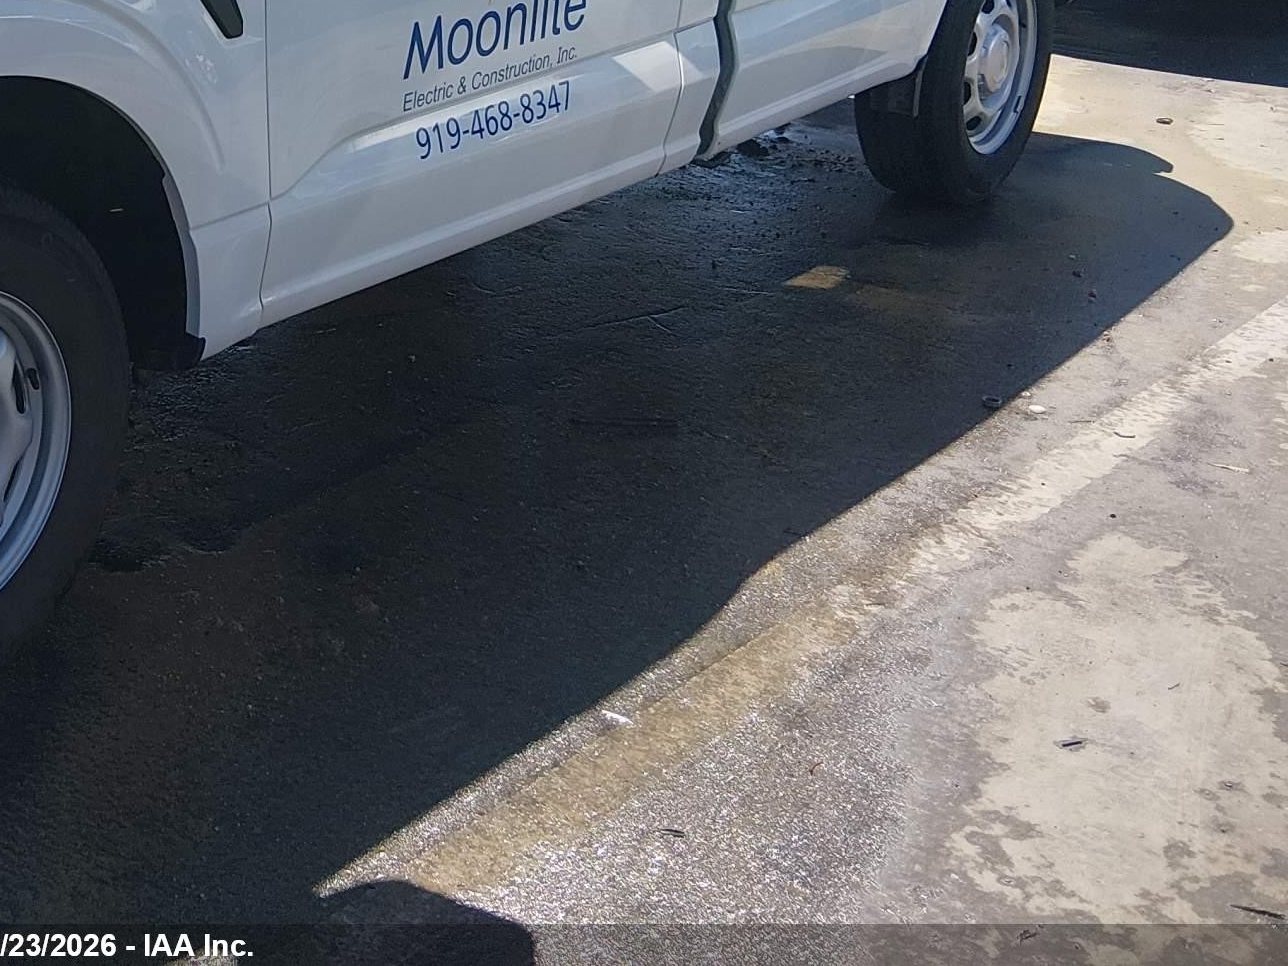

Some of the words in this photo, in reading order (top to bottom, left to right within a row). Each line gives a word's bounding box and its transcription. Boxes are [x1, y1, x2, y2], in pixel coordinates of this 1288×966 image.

[403, 81, 453, 112] Electric
[457, 76, 467, 95] &
[471, 54, 553, 91] Construction,
[557, 46, 578, 65] Inc.
[416, 80, 571, 160] 919-468-8347
